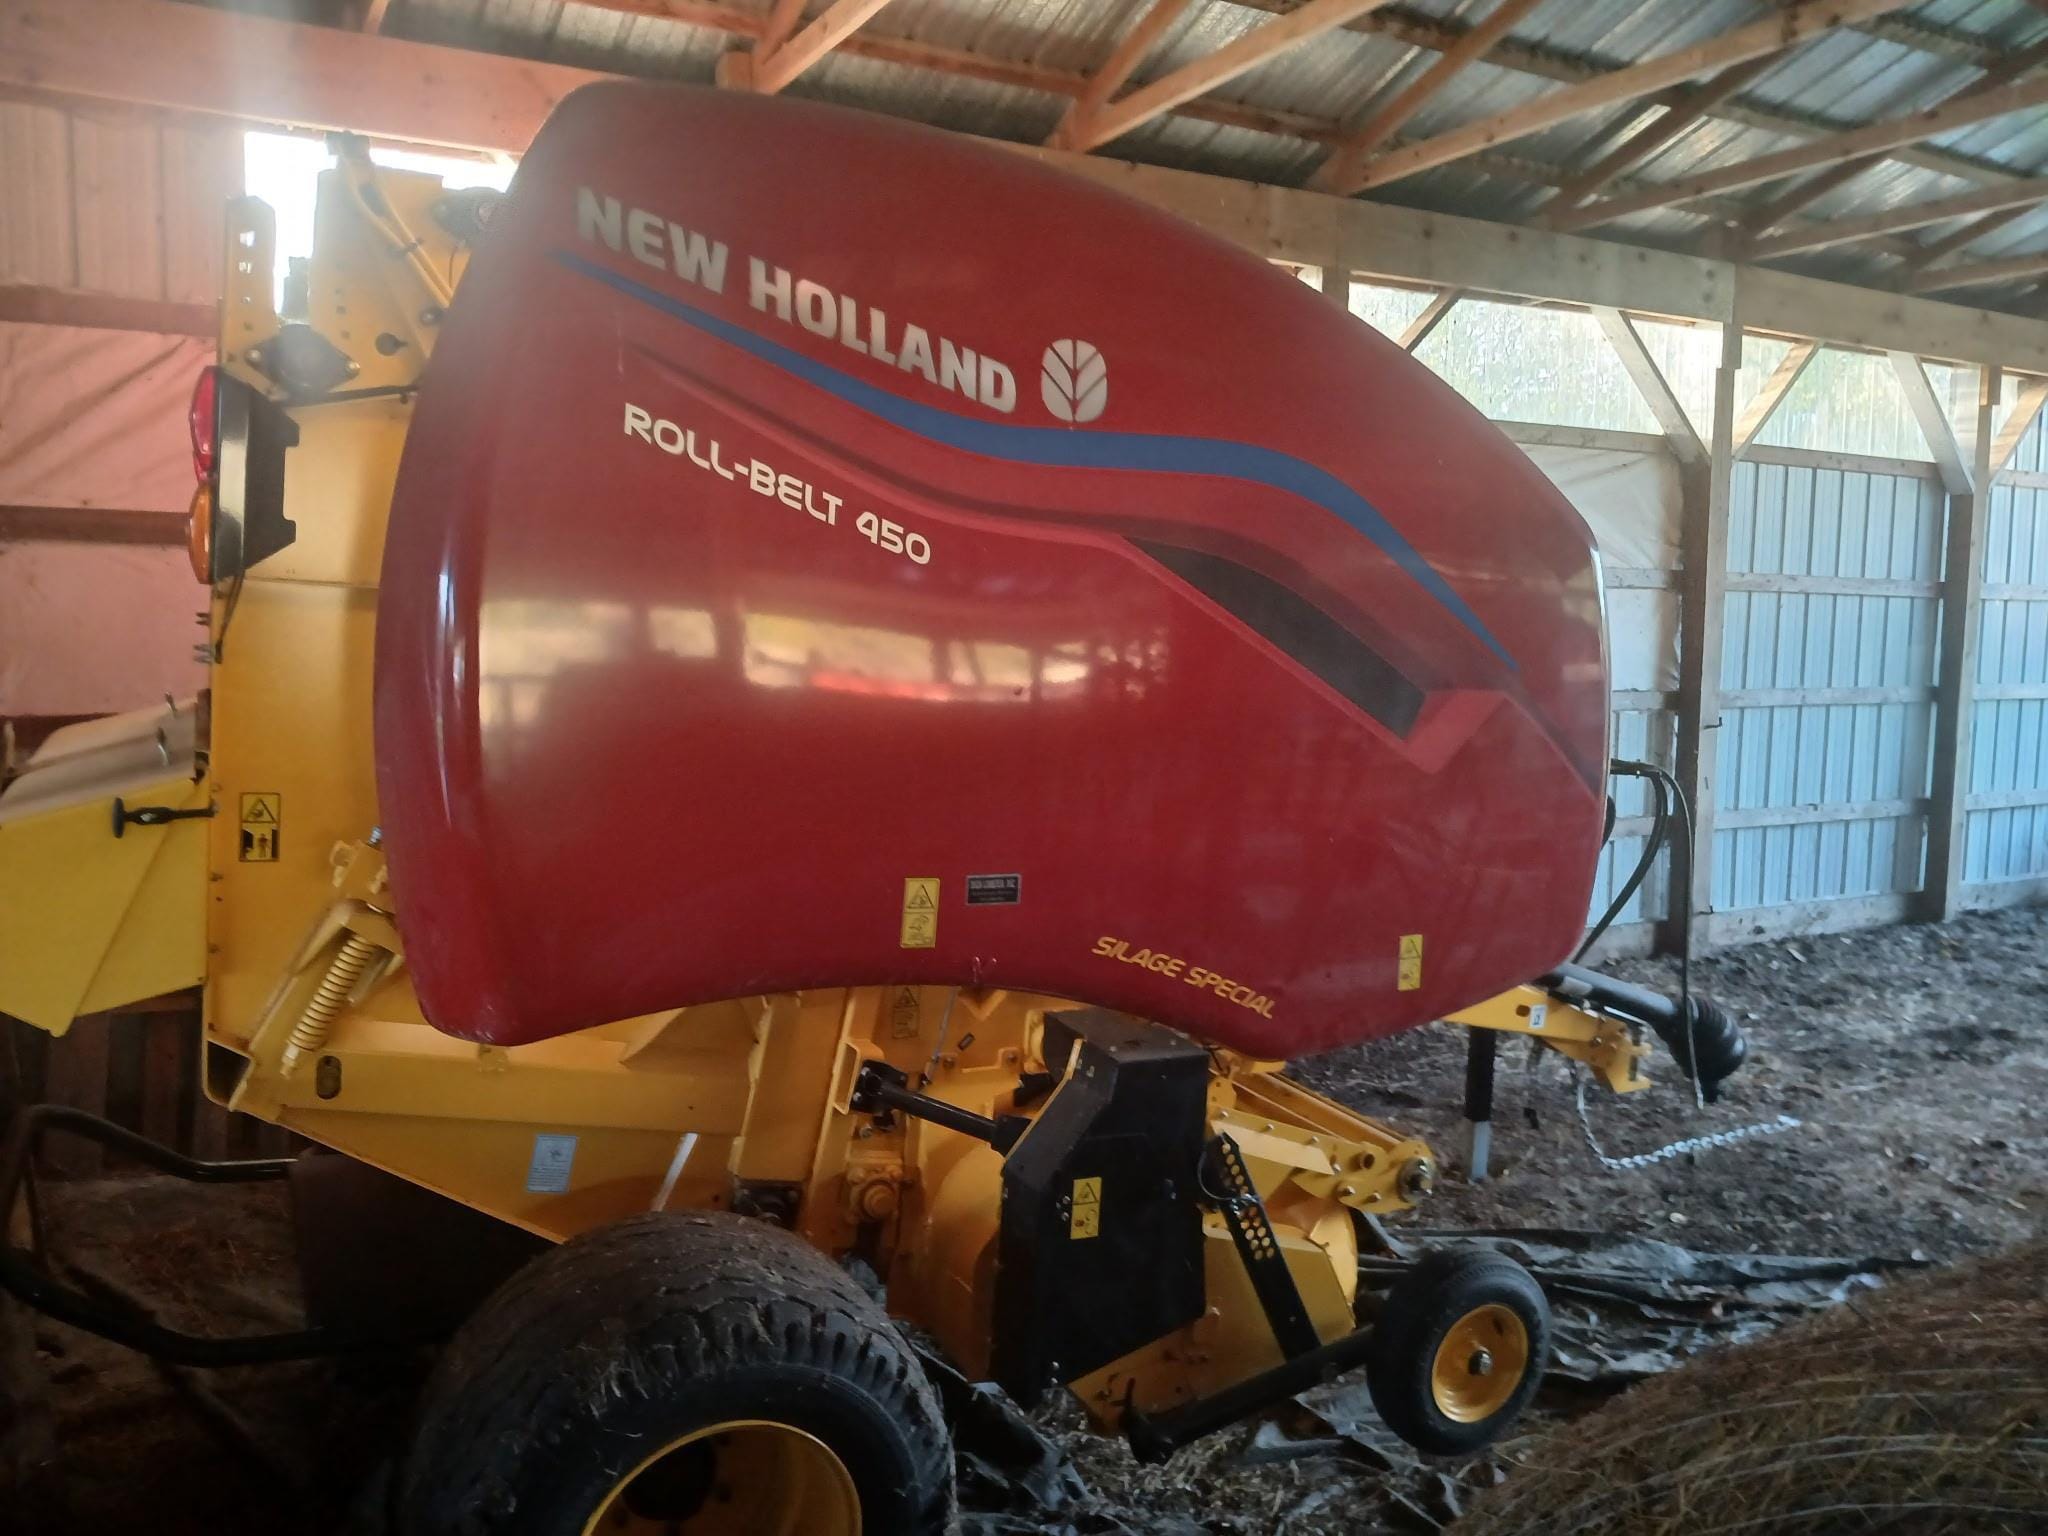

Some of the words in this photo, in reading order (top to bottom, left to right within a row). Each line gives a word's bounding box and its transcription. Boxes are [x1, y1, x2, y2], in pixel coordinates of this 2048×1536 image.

[578, 187, 728, 293] NEW
[749, 256, 1017, 413] HOLLAND
[624, 402, 842, 525] ROLL-BELT
[855, 511, 931, 564] 450
[1092, 936, 1186, 977] SILAGE
[1184, 968, 1275, 1019] SPECIAL
